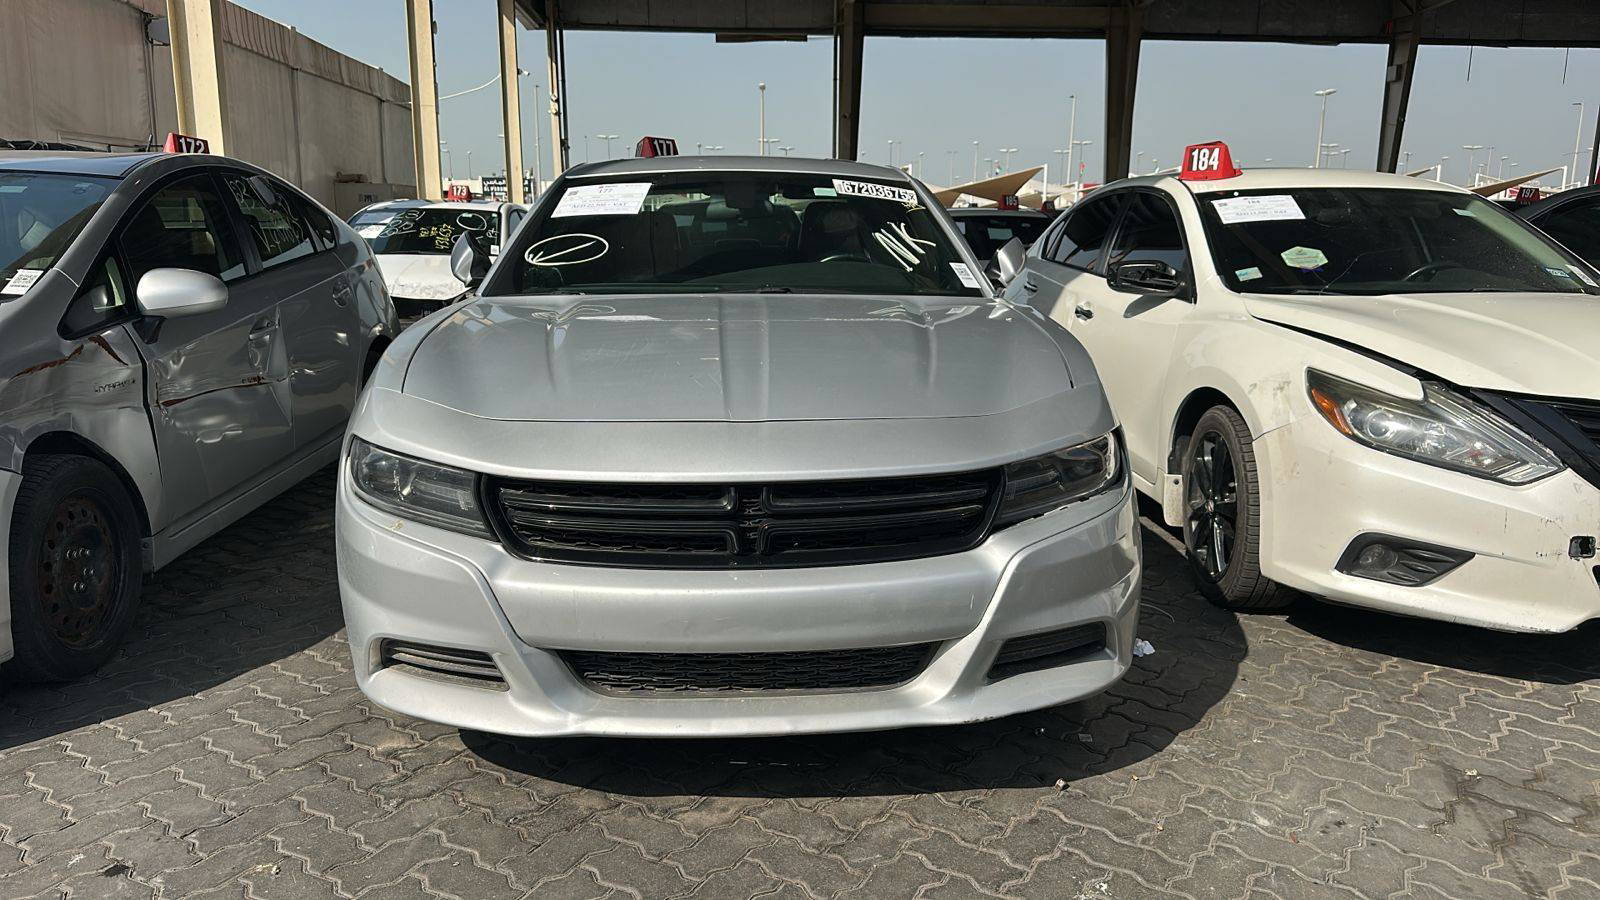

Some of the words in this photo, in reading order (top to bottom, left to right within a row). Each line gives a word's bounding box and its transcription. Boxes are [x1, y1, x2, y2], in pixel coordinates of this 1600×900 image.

[179, 136, 205, 153] 172
[653, 138, 675, 156] 177
[1191, 147, 1220, 171] 184
[452, 185, 467, 197] 173
[1521, 188, 1536, 199] 197
[1005, 195, 1018, 206] 185
